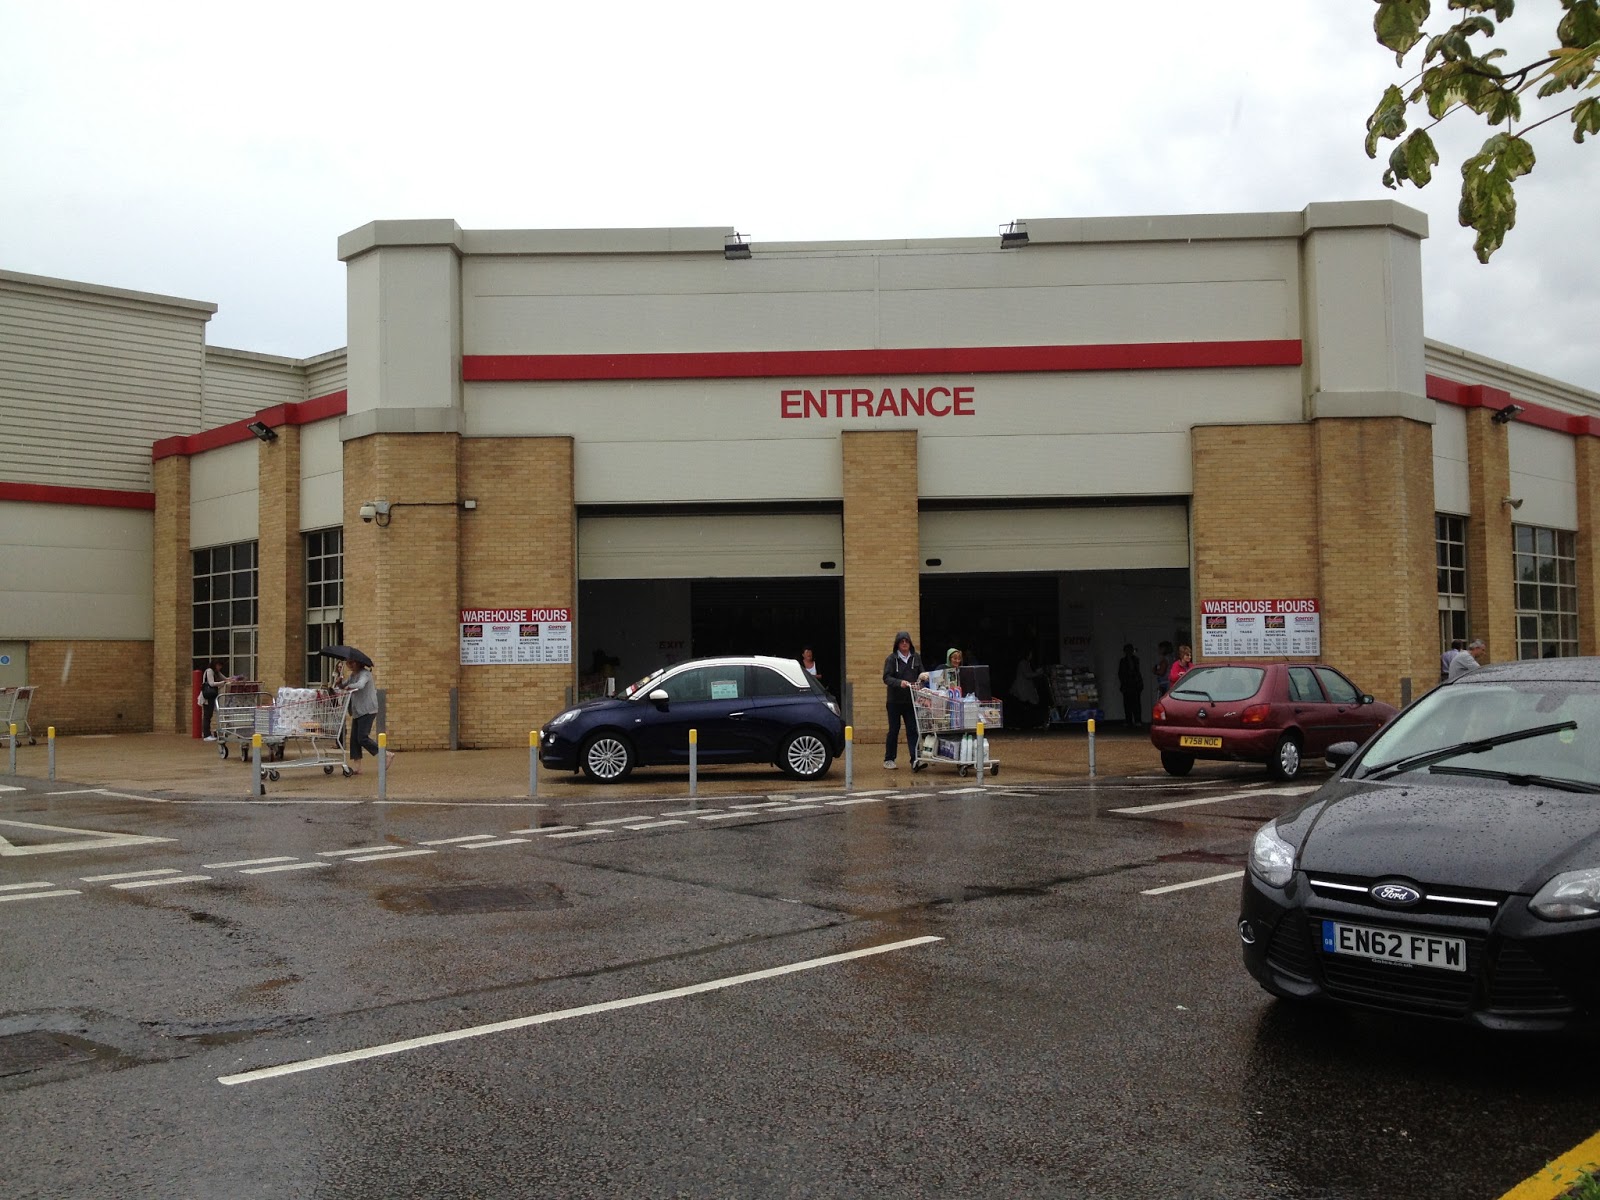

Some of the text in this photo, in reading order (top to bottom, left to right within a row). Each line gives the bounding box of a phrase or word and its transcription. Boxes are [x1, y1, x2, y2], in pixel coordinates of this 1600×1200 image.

[781, 387, 975, 419] ENTRANCE
[1204, 600, 1315, 613] WAREHOUSE HOURS
[462, 609, 568, 622] WAREHOUSE HOURS
[659, 641, 685, 649] EXIT
[1184, 737, 1218, 746] V758 NOC
[1380, 886, 1406, 900] Ford
[1324, 938, 1333, 946] GB
[1339, 926, 1460, 966] EN62 FFW
